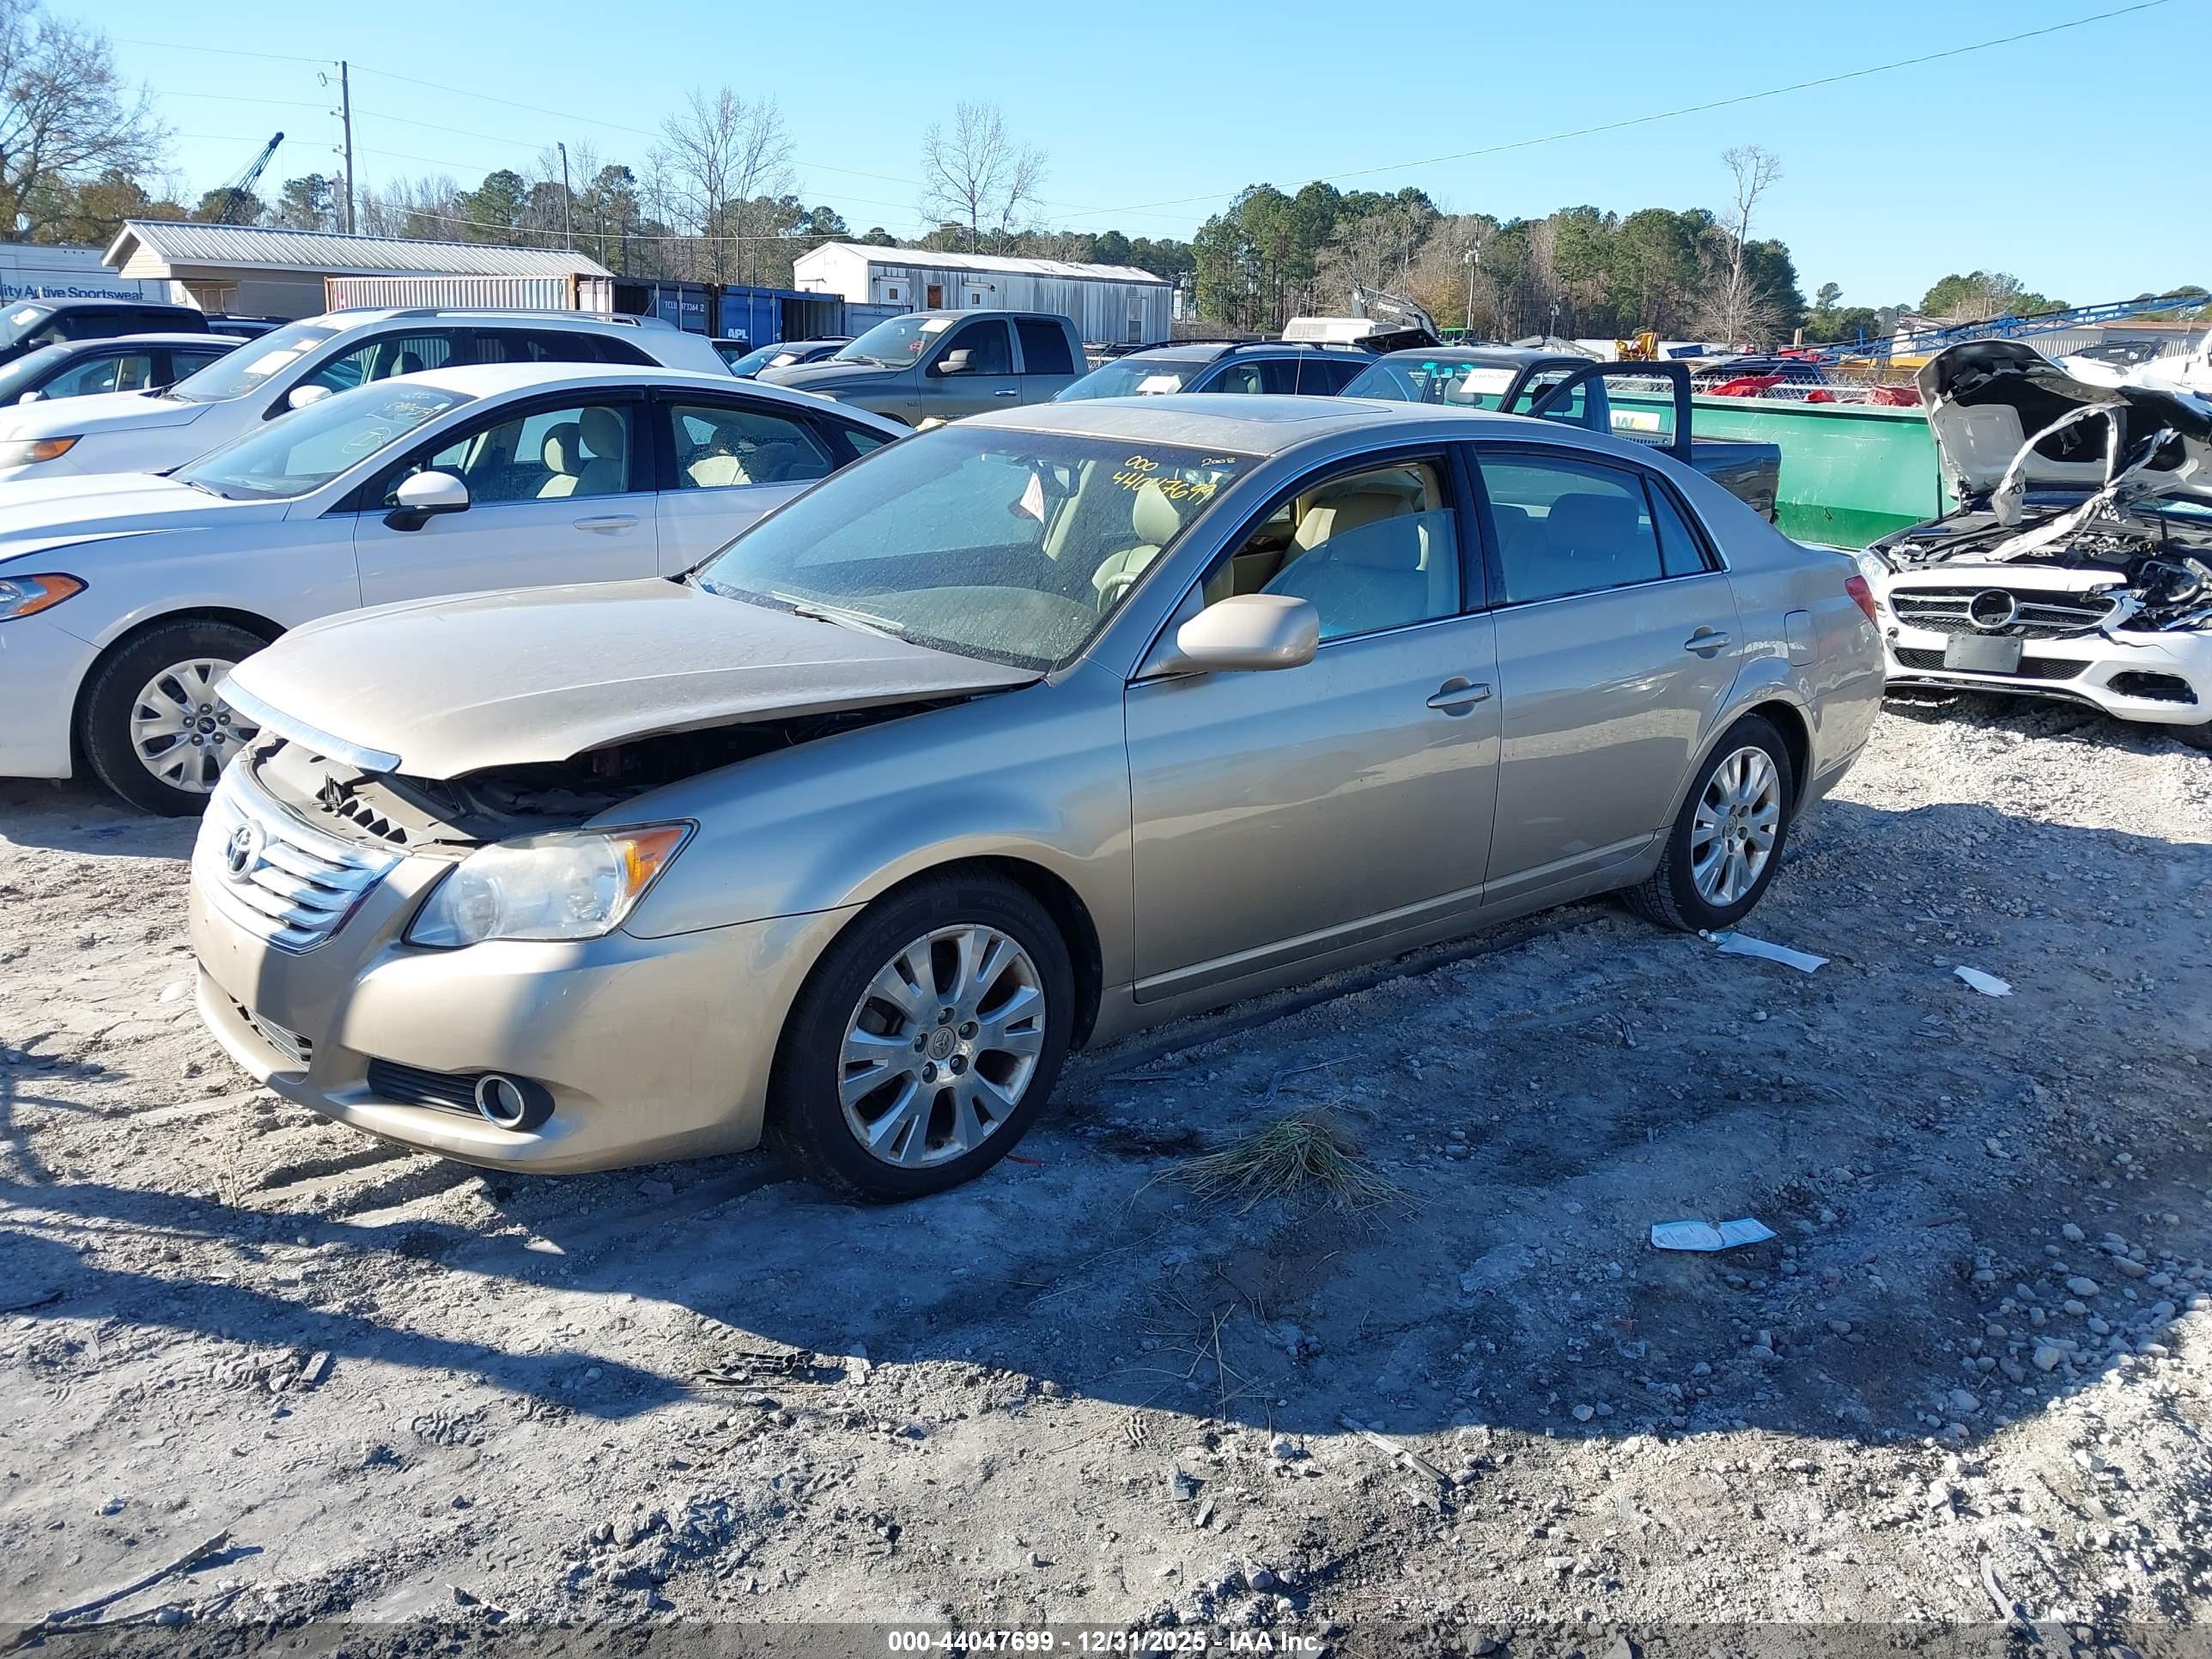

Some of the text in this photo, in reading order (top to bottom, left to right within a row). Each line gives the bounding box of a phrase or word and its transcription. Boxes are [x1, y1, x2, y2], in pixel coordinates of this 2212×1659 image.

[1377, 302, 1401, 313] DEERE
[728, 328, 748, 339] APL
[1125, 455, 1159, 471] 000
[1201, 458, 1237, 468] 2008
